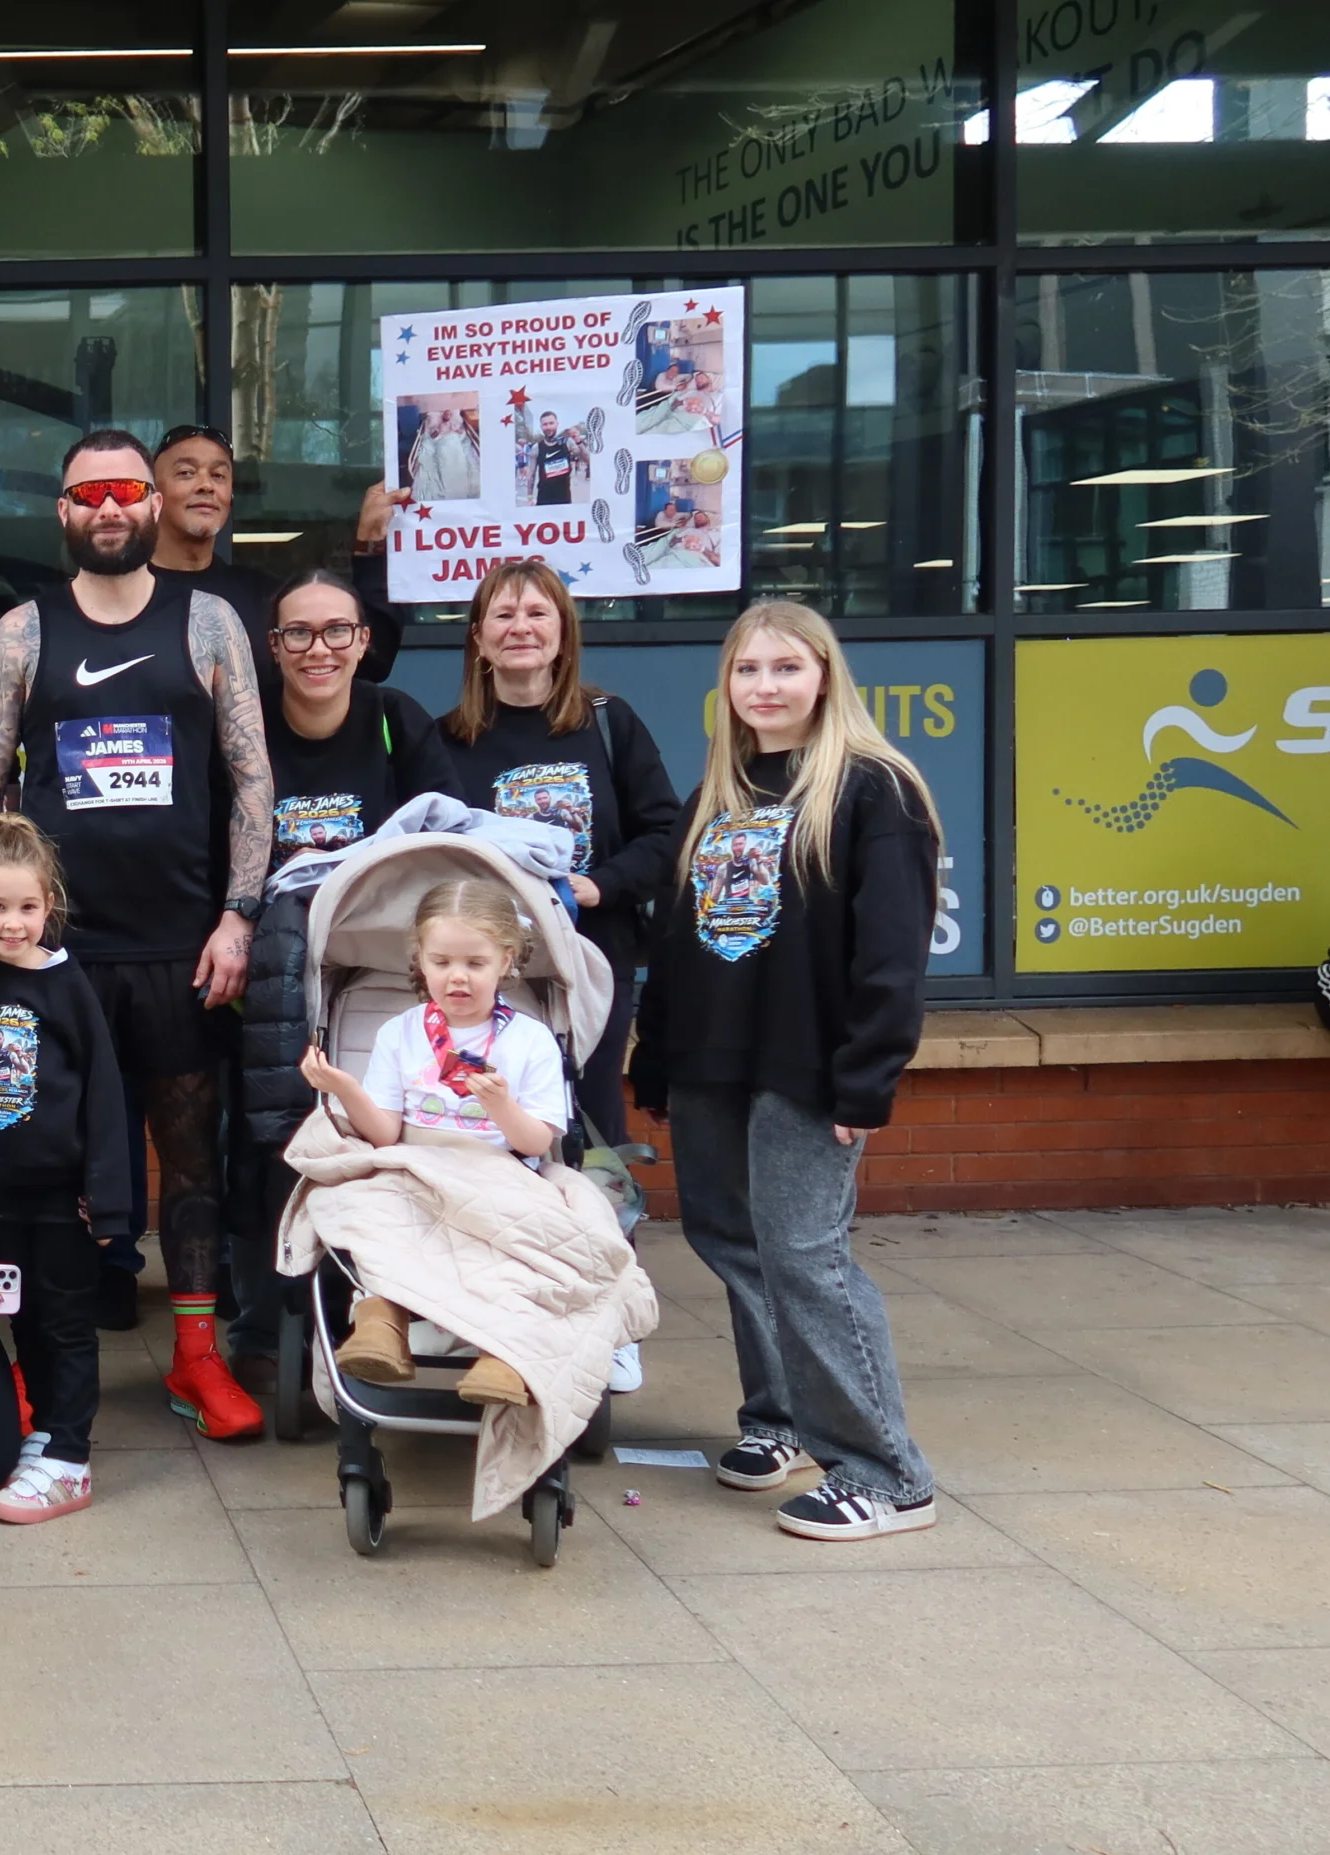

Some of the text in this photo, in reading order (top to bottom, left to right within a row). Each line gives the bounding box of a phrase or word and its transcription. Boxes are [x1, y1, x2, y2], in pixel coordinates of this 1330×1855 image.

[675, 150, 730, 205] THE
[740, 108, 821, 178] ONLY
[833, 76, 907, 142] BAD
[708, 198, 766, 250] THE
[777, 165, 848, 227] ONE
[860, 128, 940, 197] YOU
[1130, 30, 1205, 102] DO
[434, 312, 612, 341] IM SO PROUD OF
[427, 332, 619, 362] EVERYTHING YOU
[436, 353, 611, 381] HAVE ACHIEVED
[393, 520, 586, 552] I LOVE YOU
[432, 555, 546, 582] JAM
[85, 740, 144, 756] JAMES
[108, 771, 162, 789] 2944
[504, 764, 580, 783] TEAM JAMES
[282, 795, 354, 814] TEAM JAMES
[298, 808, 339, 819] 2026
[1069, 882, 1301, 910] better.org.uk/sugden
[709, 916, 762, 929] MANCHESTER
[1068, 914, 1242, 939] @BetterSugden
[0, 1005, 34, 1019] JAMES
